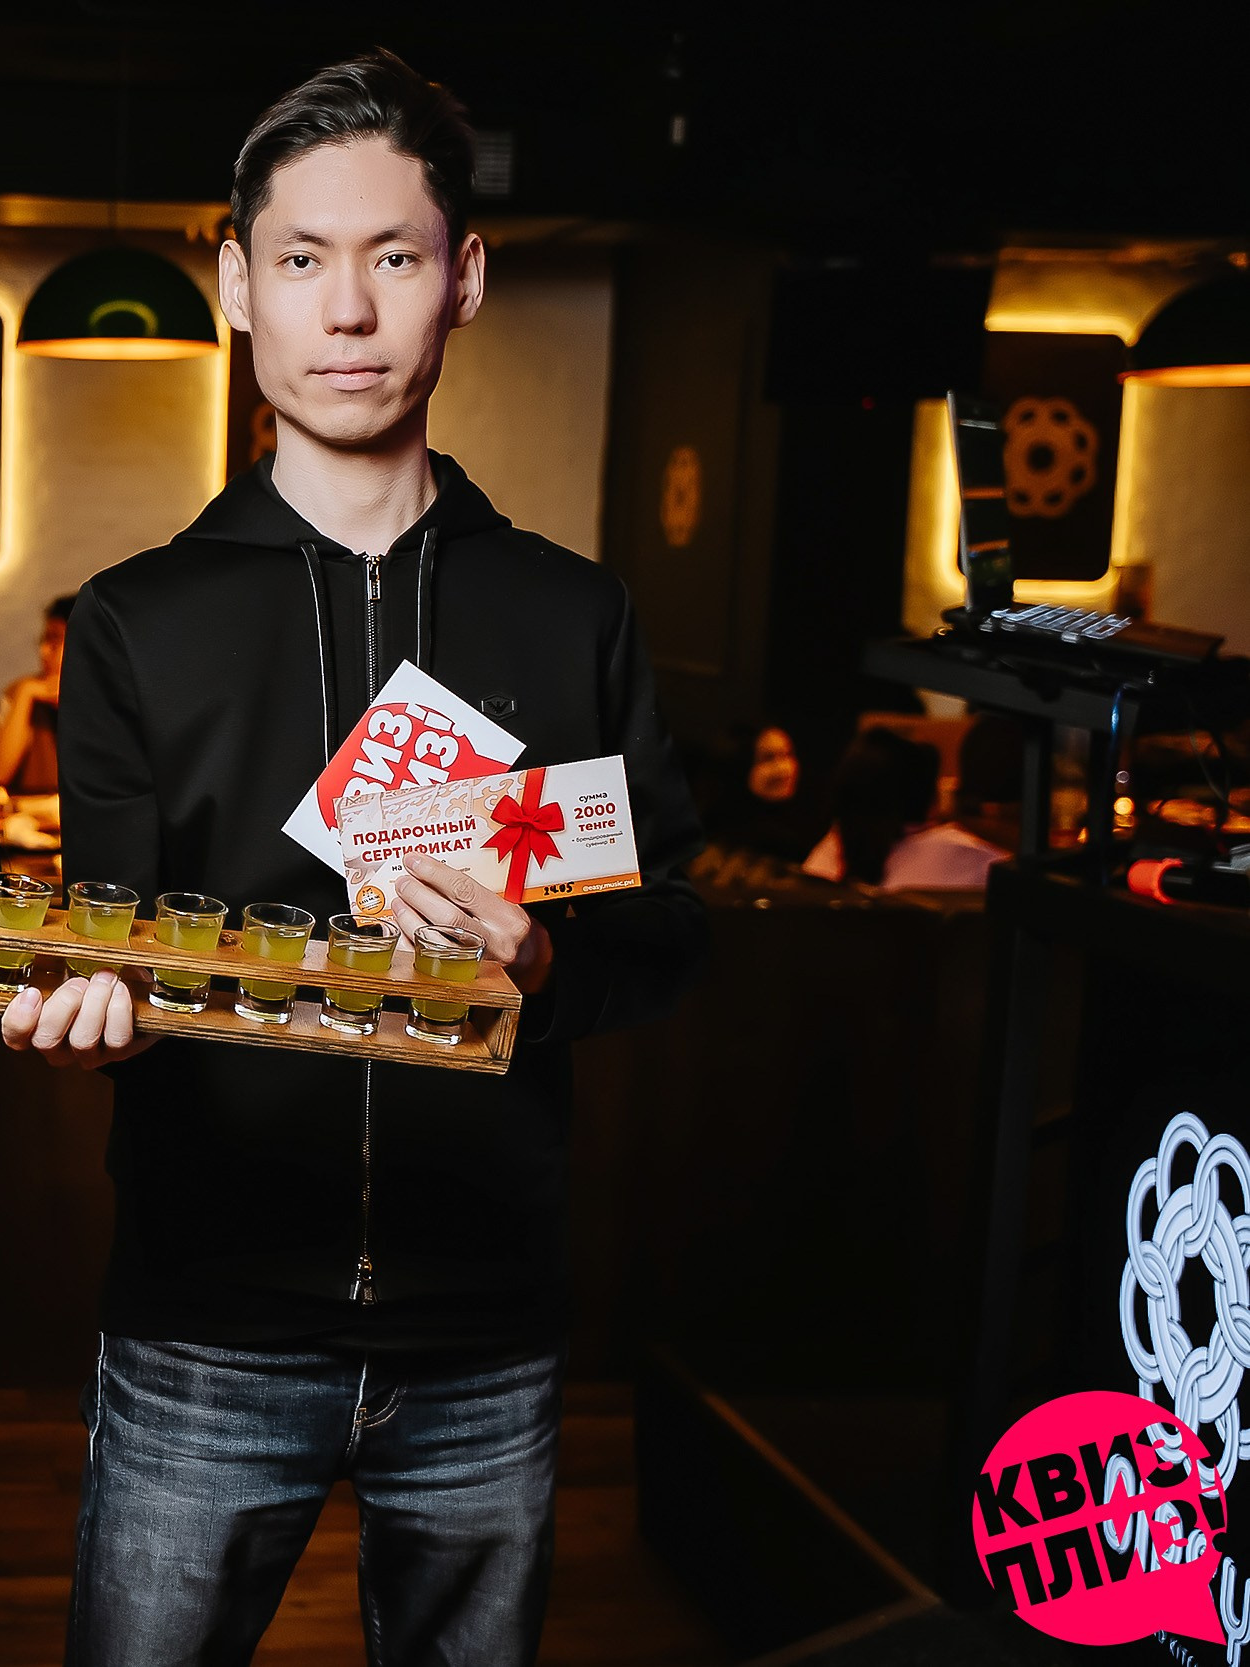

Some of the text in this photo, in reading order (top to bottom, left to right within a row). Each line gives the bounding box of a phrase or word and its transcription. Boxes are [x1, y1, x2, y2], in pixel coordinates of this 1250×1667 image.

[579, 792, 608, 803] сумма
[574, 802, 616, 820] 2000
[353, 815, 477, 846] ПОДАРОЧНЫЙ
[578, 820, 616, 832] тенге
[362, 837, 472, 863] СЕРТИФИКАТ
[392, 864, 403, 872] на
